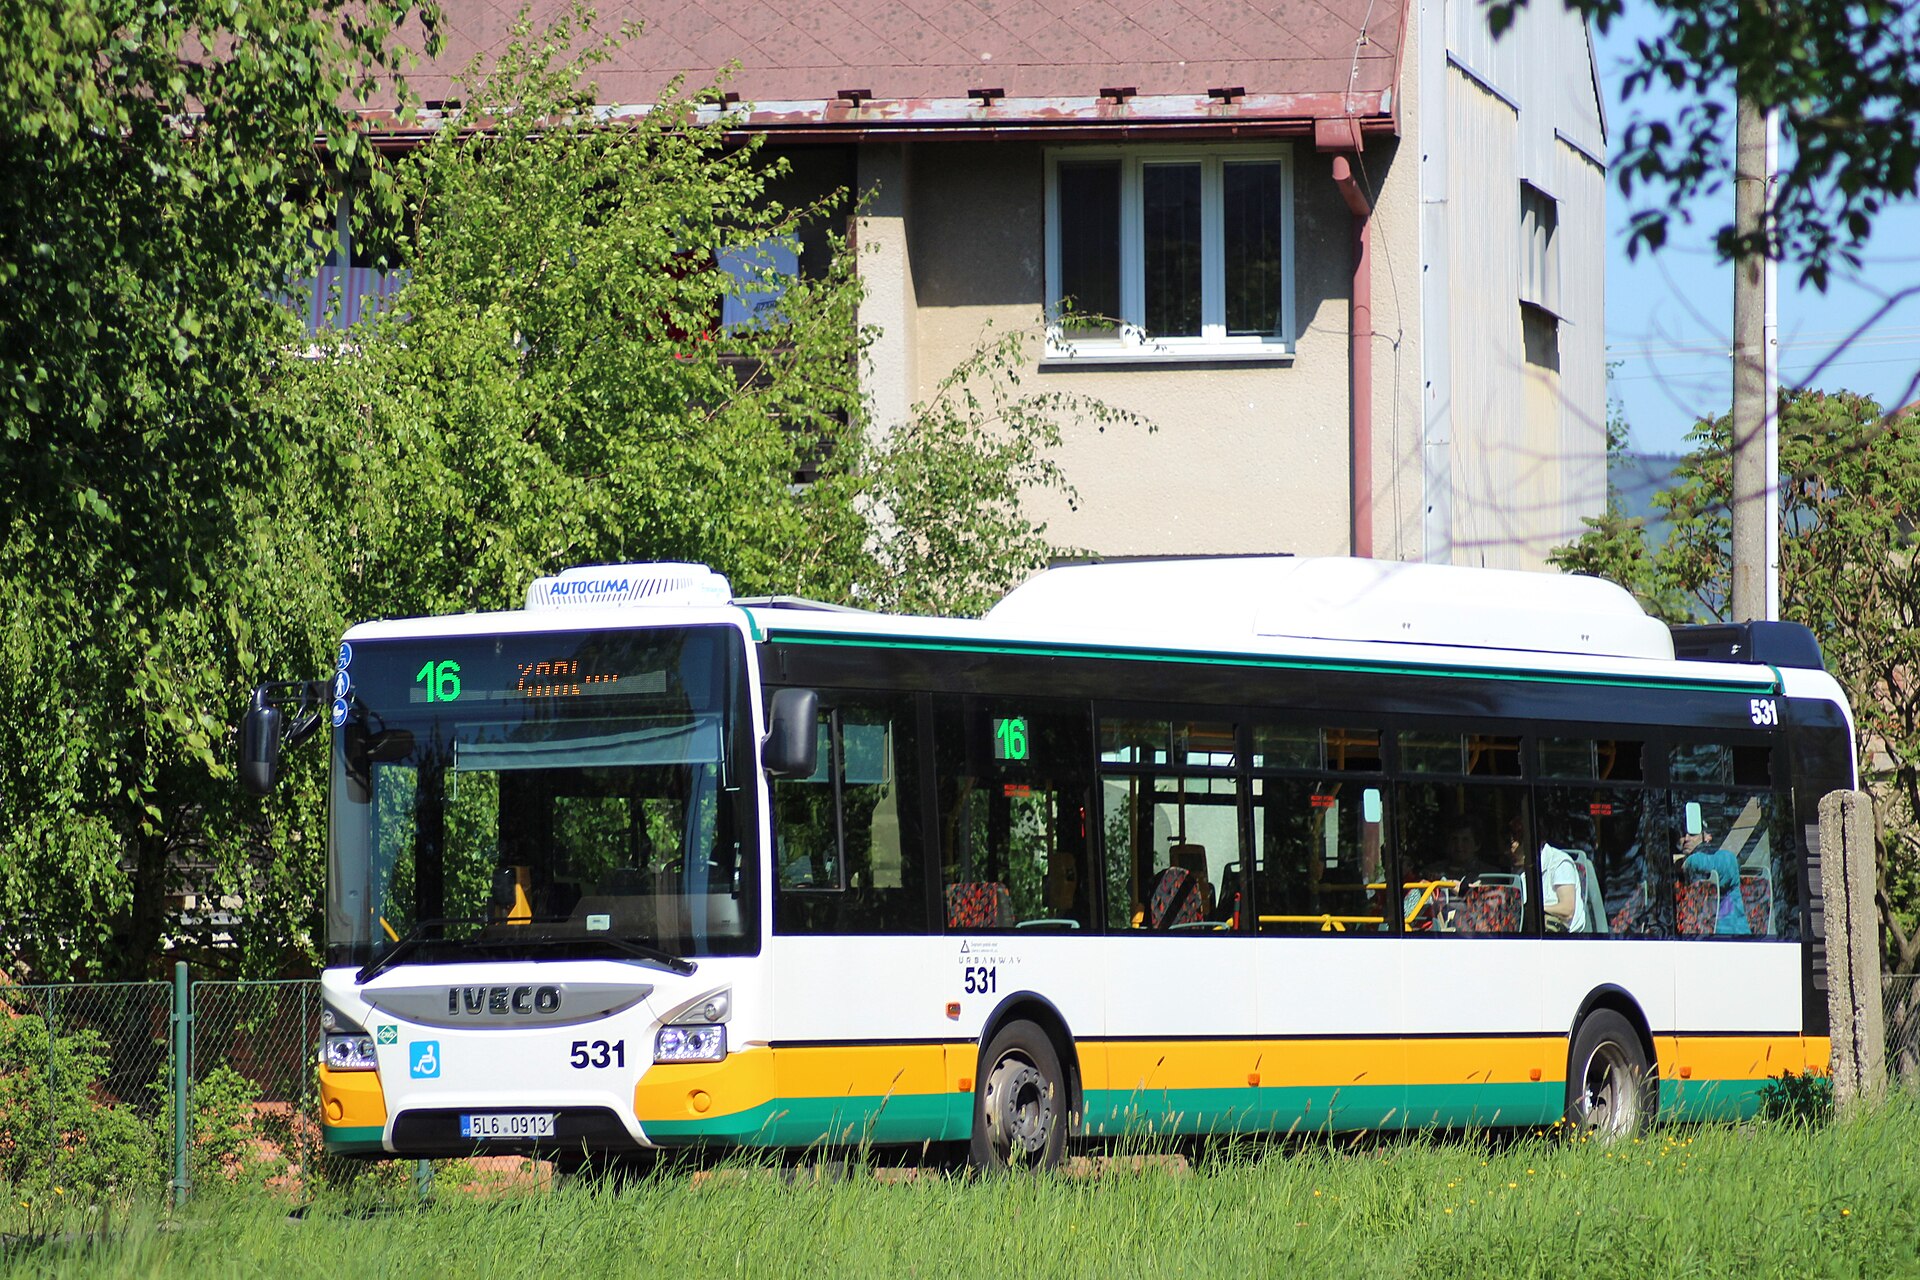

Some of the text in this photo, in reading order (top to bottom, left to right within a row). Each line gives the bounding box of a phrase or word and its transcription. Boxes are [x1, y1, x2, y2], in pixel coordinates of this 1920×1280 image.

[550, 578, 629, 595] AUTOCLIMA
[416, 659, 461, 703] 16
[1750, 699, 1779, 725] 531
[997, 718, 1026, 760] 16
[964, 966, 996, 994] 531
[448, 985, 562, 1015] IVECO
[570, 1040, 625, 1068] 531
[473, 1116, 547, 1134] 5L6 0913
